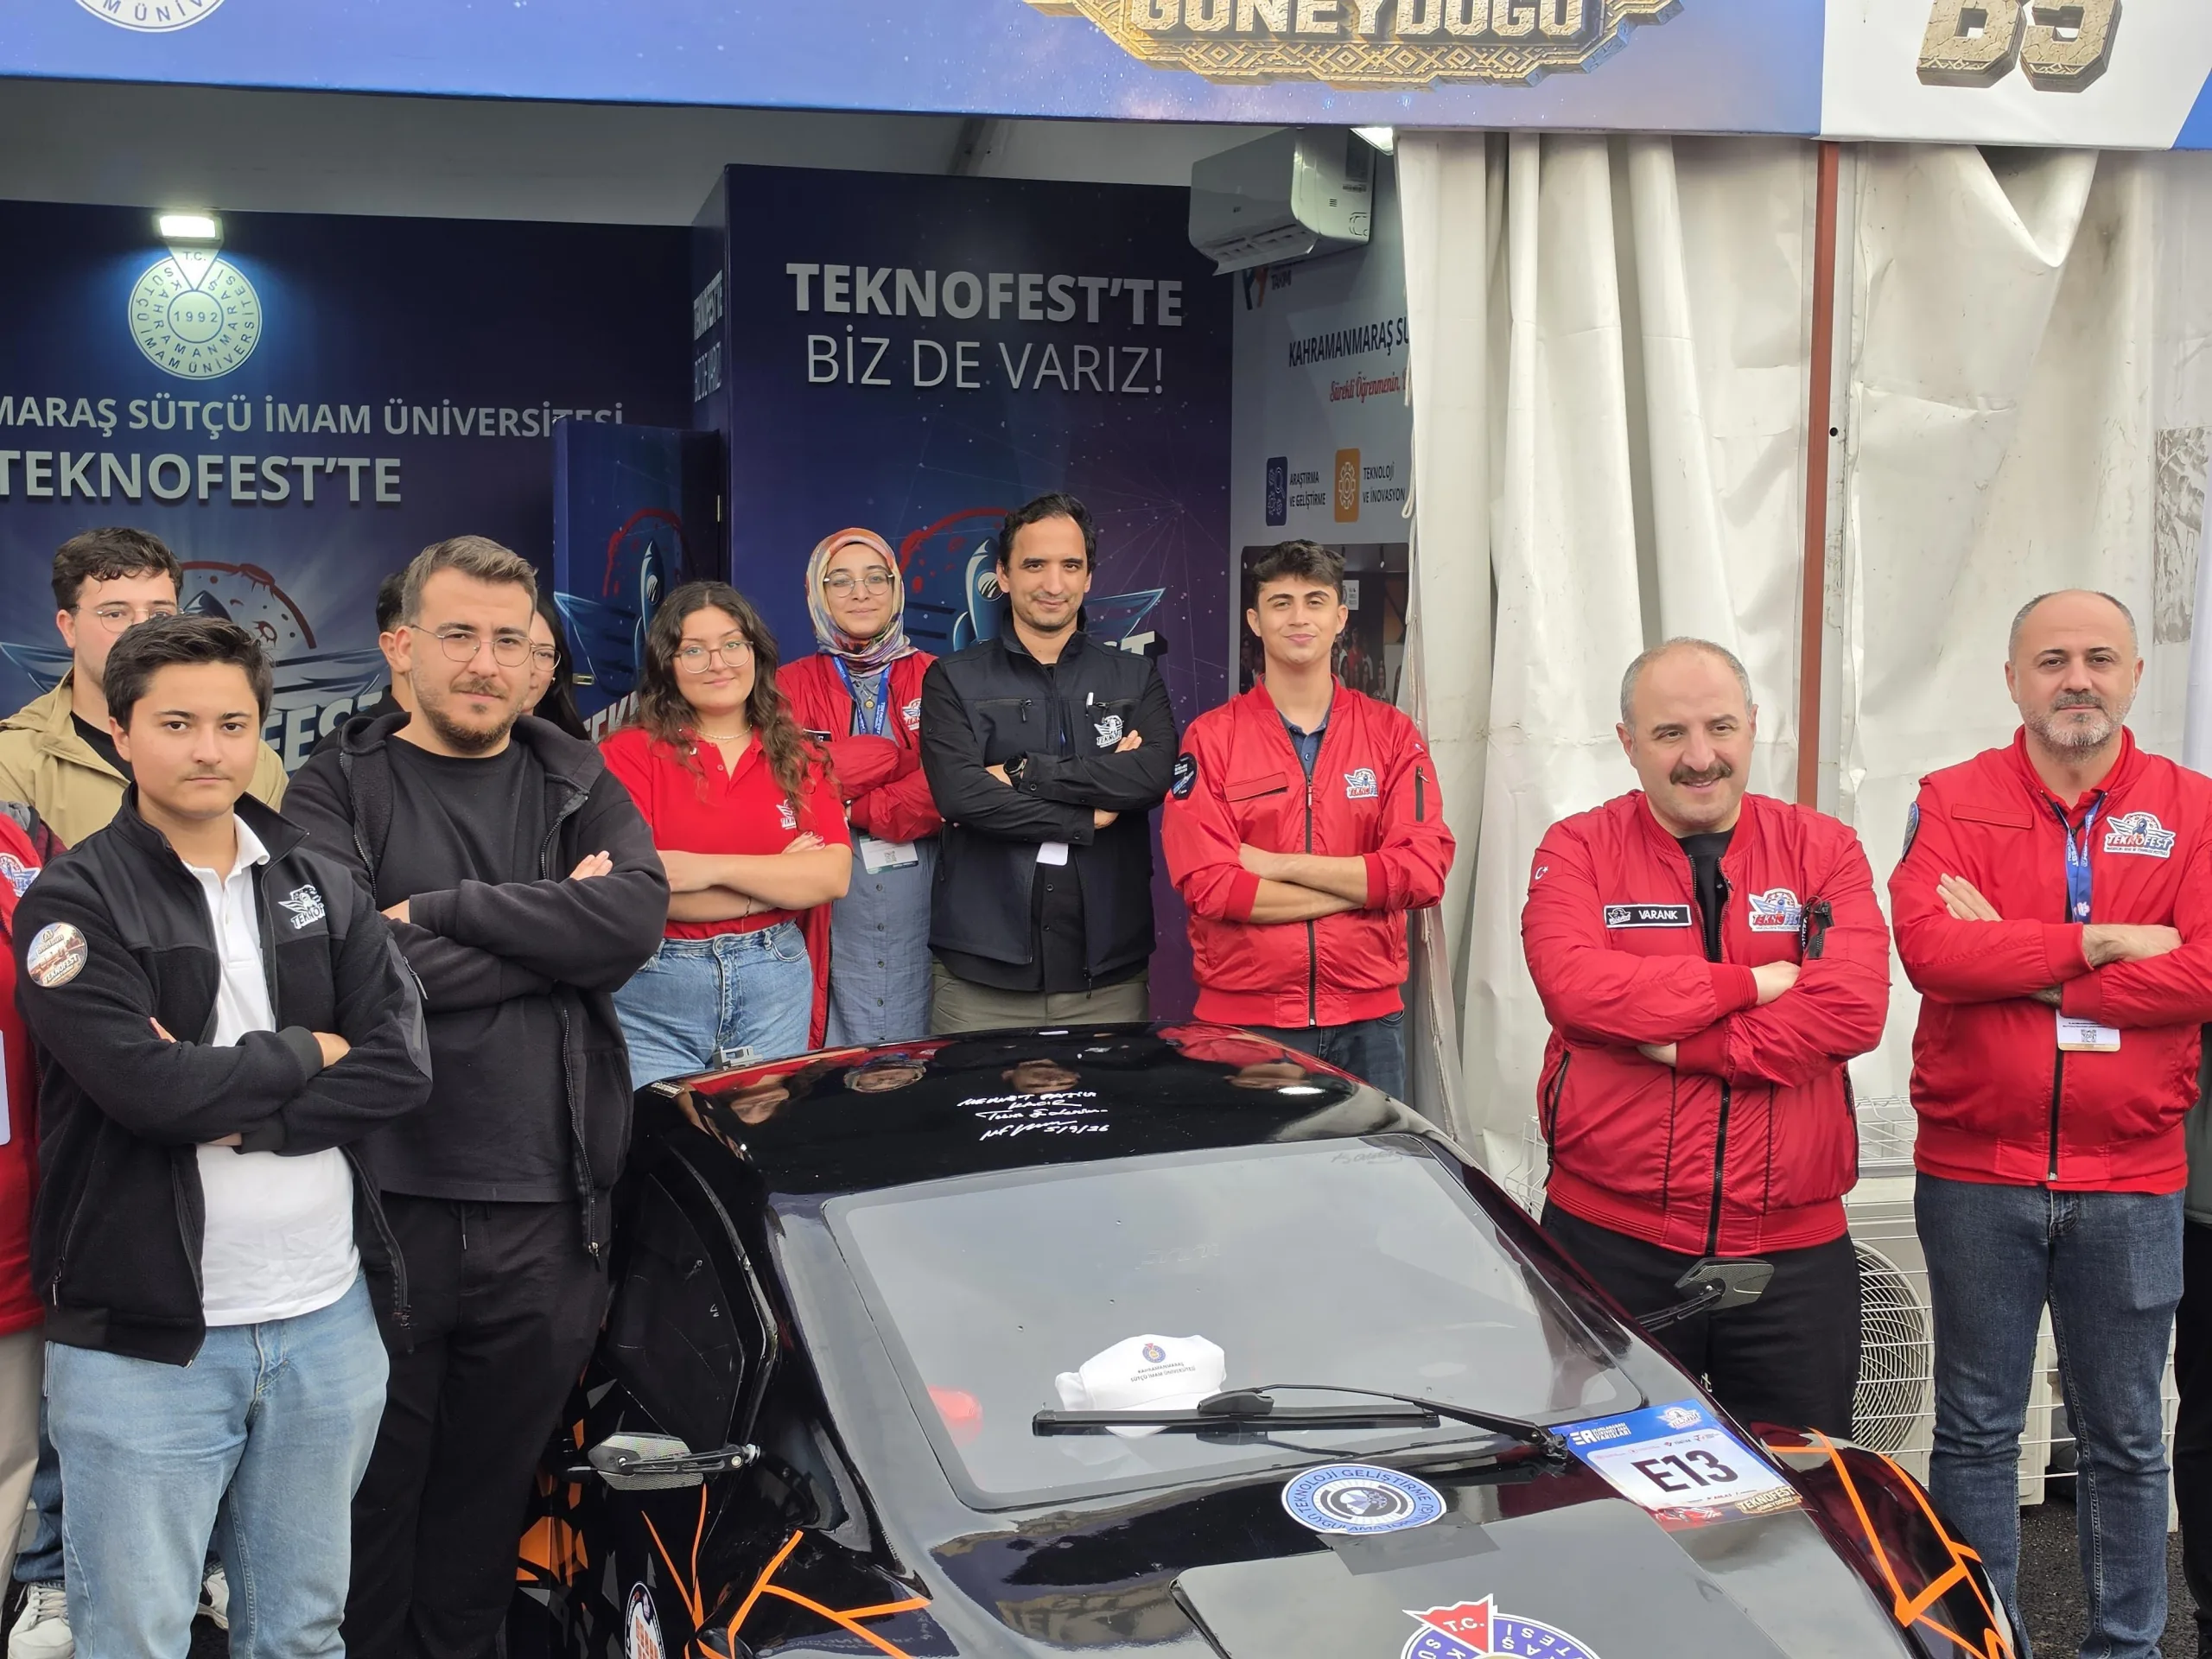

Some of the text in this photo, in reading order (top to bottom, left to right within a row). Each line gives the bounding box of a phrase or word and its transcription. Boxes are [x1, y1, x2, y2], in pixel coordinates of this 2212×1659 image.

[785, 263, 1183, 327] TEKNOFEST'TE
[174, 311, 219, 323] 1992
[1288, 319, 1394, 368] KAHRAMANMARAŞ
[808, 324, 1163, 395] BİZ DE VARIZ!
[129, 391, 252, 441] SÜTÇÜ
[264, 394, 371, 434] İMAM
[1288, 471, 1319, 489] ARAŞTIRMA
[1363, 461, 1395, 481] TEKNOLOJİ
[1295, 490, 1326, 511] GELİŞTİRME
[1362, 486, 1406, 504] VE İNOVASYON
[2107, 835, 2171, 850] TEKNOFEST
[1638, 909, 1679, 919] VARANK
[1630, 1450, 1738, 1493] E13
[1294, 1469, 1432, 1514] TEKNOLOJİ GELİŞTİRME
[1738, 1486, 1796, 1511] TEKNOFEST
[1442, 1617, 1485, 1632] T.C.
